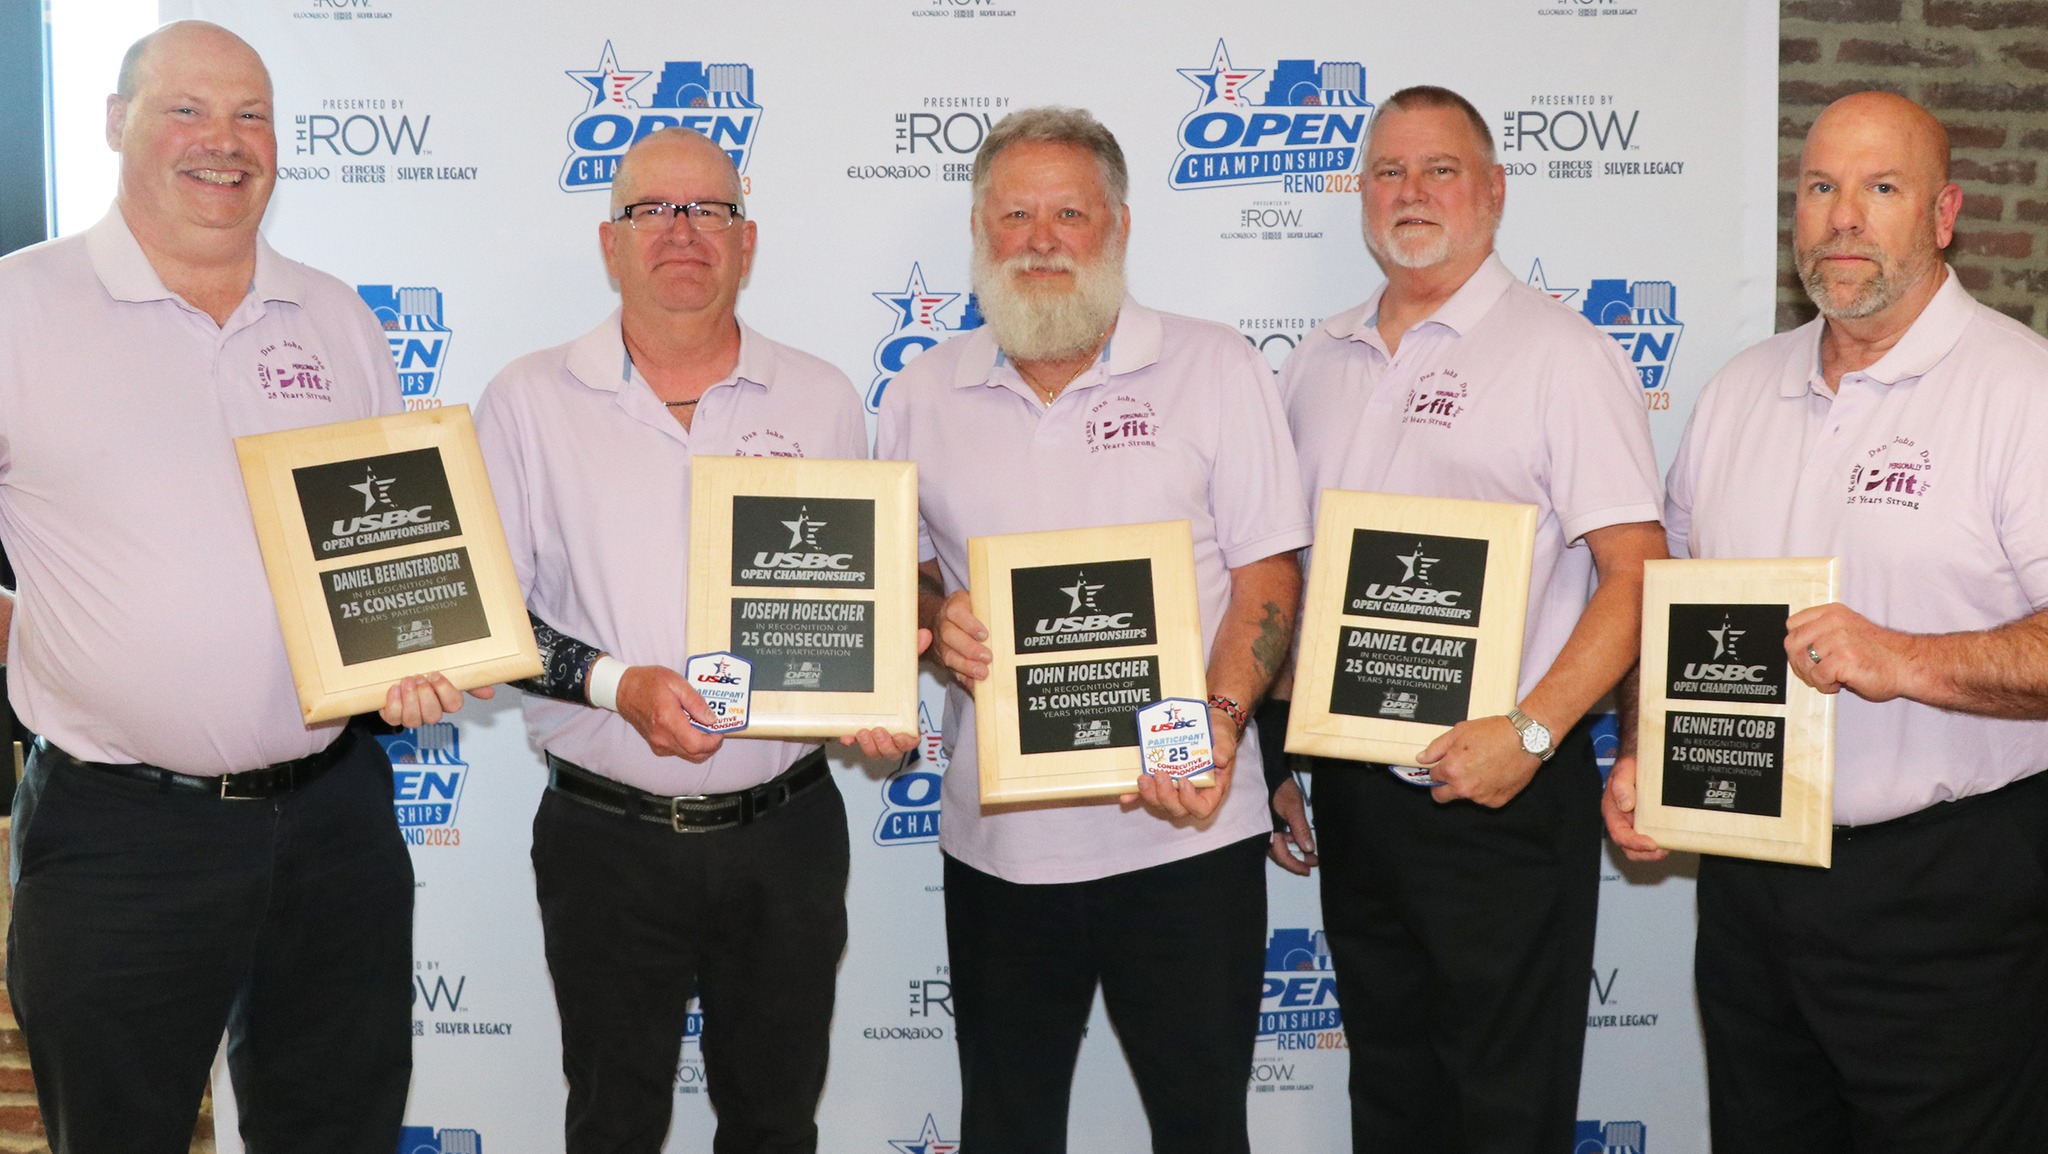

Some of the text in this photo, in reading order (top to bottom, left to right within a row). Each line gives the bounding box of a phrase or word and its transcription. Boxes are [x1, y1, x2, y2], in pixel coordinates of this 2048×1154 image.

[323, 99, 404, 109] PRESENTED BY
[924, 98, 1010, 107] PRESENTED BY
[1532, 96, 1614, 105] PRESENTED BY
[296, 115, 306, 155] THE
[310, 115, 430, 156] ROW
[896, 113, 907, 153] THE
[1185, 112, 1365, 149] OPEN
[1504, 111, 1514, 151] THE
[1518, 111, 1639, 151] ROW
[343, 165, 385, 174] CIRCUS
[943, 164, 973, 172] CIRC
[1189, 151, 1344, 177] CHAMPIONSHIPS
[1549, 161, 1592, 169] CIRCUS
[1604, 162, 1683, 176] SILVER LEGACY
[277, 167, 329, 180] ORADO
[343, 175, 385, 183] CIRCUS
[397, 167, 478, 182] SILVER LEGACY
[943, 173, 973, 181] CIRC
[1549, 170, 1592, 178] CIRCUS
[1247, 209, 1302, 227] ROW
[1240, 319, 1304, 328] PRESENTED
[1868, 445, 1887, 457] Dan
[1889, 463, 1922, 471] PERSONALLY
[1920, 450, 1931, 470] Dan
[1848, 464, 1861, 492] Kenny
[1917, 481, 1930, 496] Joe
[1886, 497, 1919, 510] Strong
[332, 505, 432, 536] USBC
[323, 520, 450, 551] OPEN CHAMPIONSHIPS
[753, 552, 853, 569] USBC
[333, 553, 460, 592] DANIEL BEEMSTERBOER
[741, 569, 865, 582] OPEN CHAMPIONSHIPS
[366, 579, 433, 598] RECOGNITION
[437, 575, 447, 584] OF
[341, 582, 467, 618] 25 CONSECUTIVE
[1365, 583, 1462, 606] USBC
[359, 601, 457, 624] YEARS PARTICIPATION
[742, 602, 864, 621] JOSEPH HOELSCHER
[1352, 599, 1471, 619] OPEN CHAMPIONSHIPS
[768, 623, 834, 631] RECOGNITION
[1035, 613, 1133, 634] USBC
[399, 628, 432, 641] OPEN
[742, 632, 863, 647] 25 CONSECUTIVE
[1024, 628, 1147, 647] OPEN CHAMPIONSHIPS
[1348, 631, 1466, 657] DANIEL CLARK
[1372, 652, 1434, 665] RECOGNITION
[1027, 660, 1149, 685] JOHN HOELSCHER
[1345, 659, 1462, 683] 25 CONSECUTIVE
[1684, 663, 1768, 682] USBC
[698, 675, 741, 684] USBC
[1357, 675, 1448, 691] YEARS PARTICIPATION
[697, 689, 744, 698] ARTICIPANT
[1054, 682, 1119, 693] RECOGNITION
[1674, 682, 1777, 695] OPEN CHAMPIONSHIPS
[1029, 688, 1151, 711] 25 CONSECUTIVE
[1383, 700, 1417, 709] OPEN
[1075, 705, 1138, 715] PARTICIPATION
[1151, 719, 1197, 732] USBC
[1673, 716, 1775, 739] KENNETH COBB
[1075, 730, 1110, 738] OPEN
[1148, 733, 1204, 745] PARTICIPANT
[1694, 739, 1748, 748] RECOGNITION
[1169, 747, 1188, 762] 25
[1672, 747, 1774, 768] 25 CONSECUTIVE
[1157, 758, 1202, 770] CONSECUTIVE
[1683, 764, 1762, 777] YEARS PARTICIPATION
[394, 772, 460, 800] EN
[1706, 790, 1736, 799] OPEN
[403, 829, 460, 846] NO2023
[428, 961, 439, 969] BY
[910, 980, 920, 1016] THE
[1263, 978, 1338, 1007] PEN
[1259, 1011, 1335, 1031] IONSHIPS
[1588, 1014, 1658, 1028] ILVER LEGACY
[436, 1023, 470, 1035] SILVER
[473, 1023, 512, 1034] LEGACY
